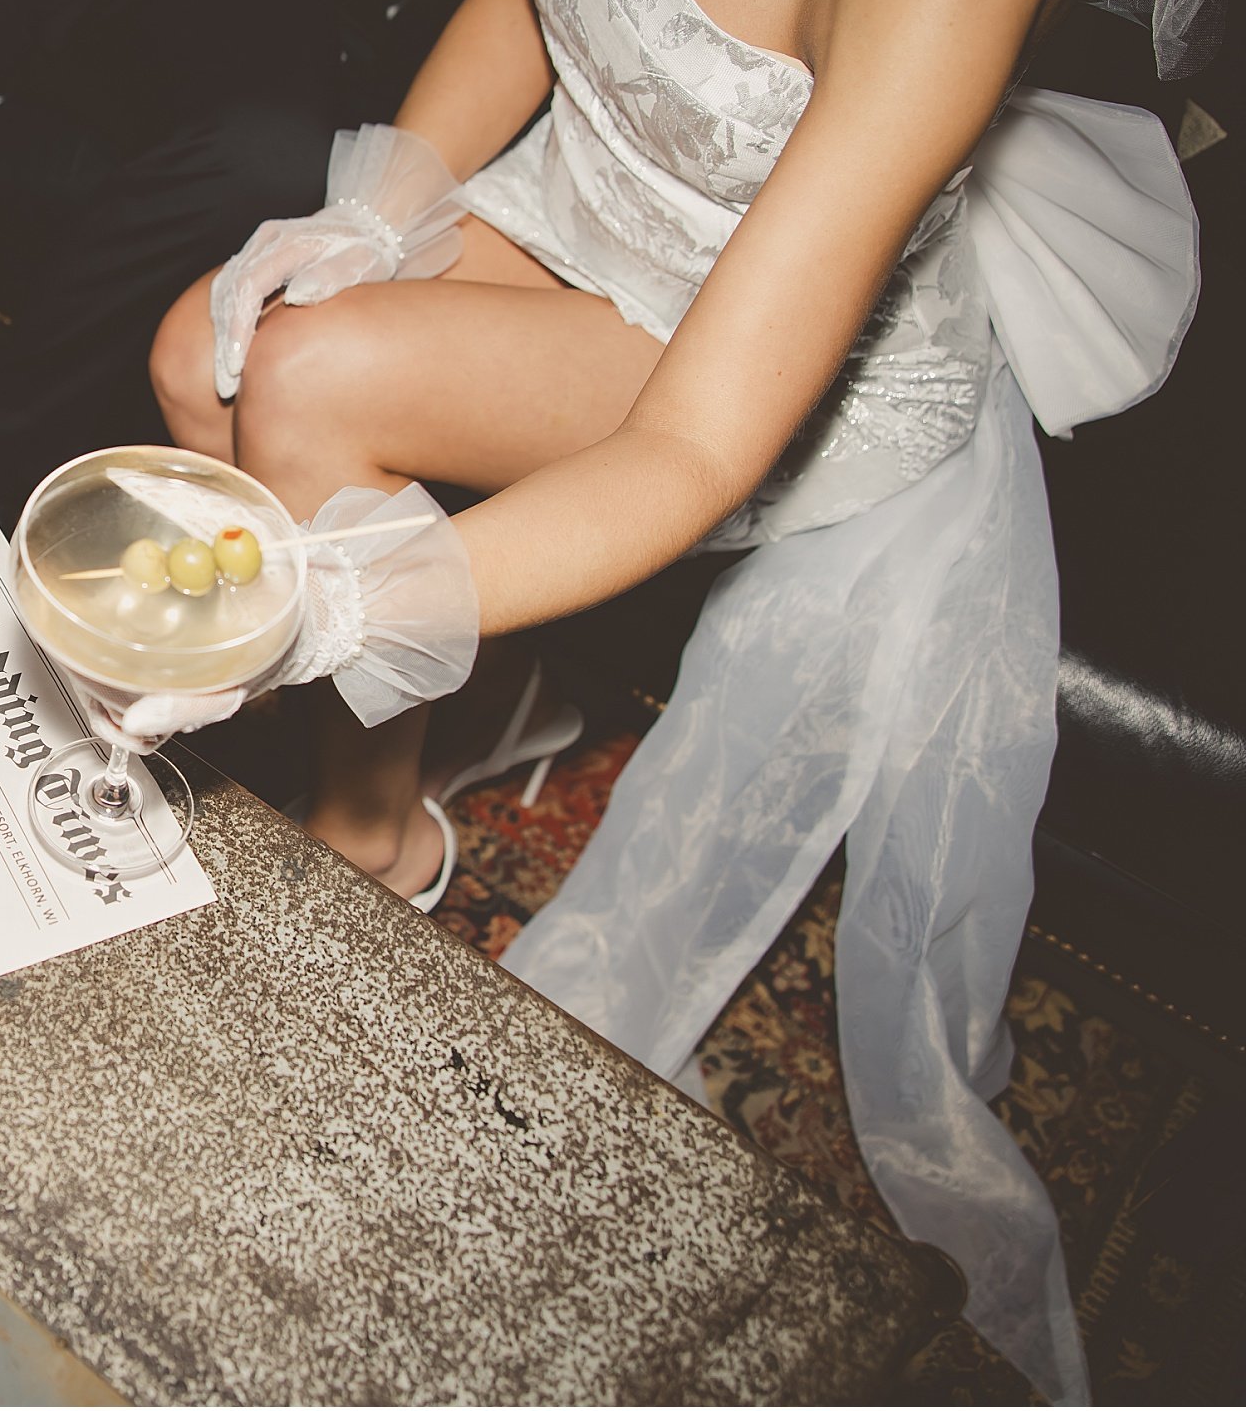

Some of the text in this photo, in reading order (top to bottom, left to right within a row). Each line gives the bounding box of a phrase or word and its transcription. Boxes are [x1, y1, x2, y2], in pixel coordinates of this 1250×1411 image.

[12, 851, 46, 908] ELKHORN,
[38, 908, 57, 925] WI
[34, 768, 134, 906] Times
